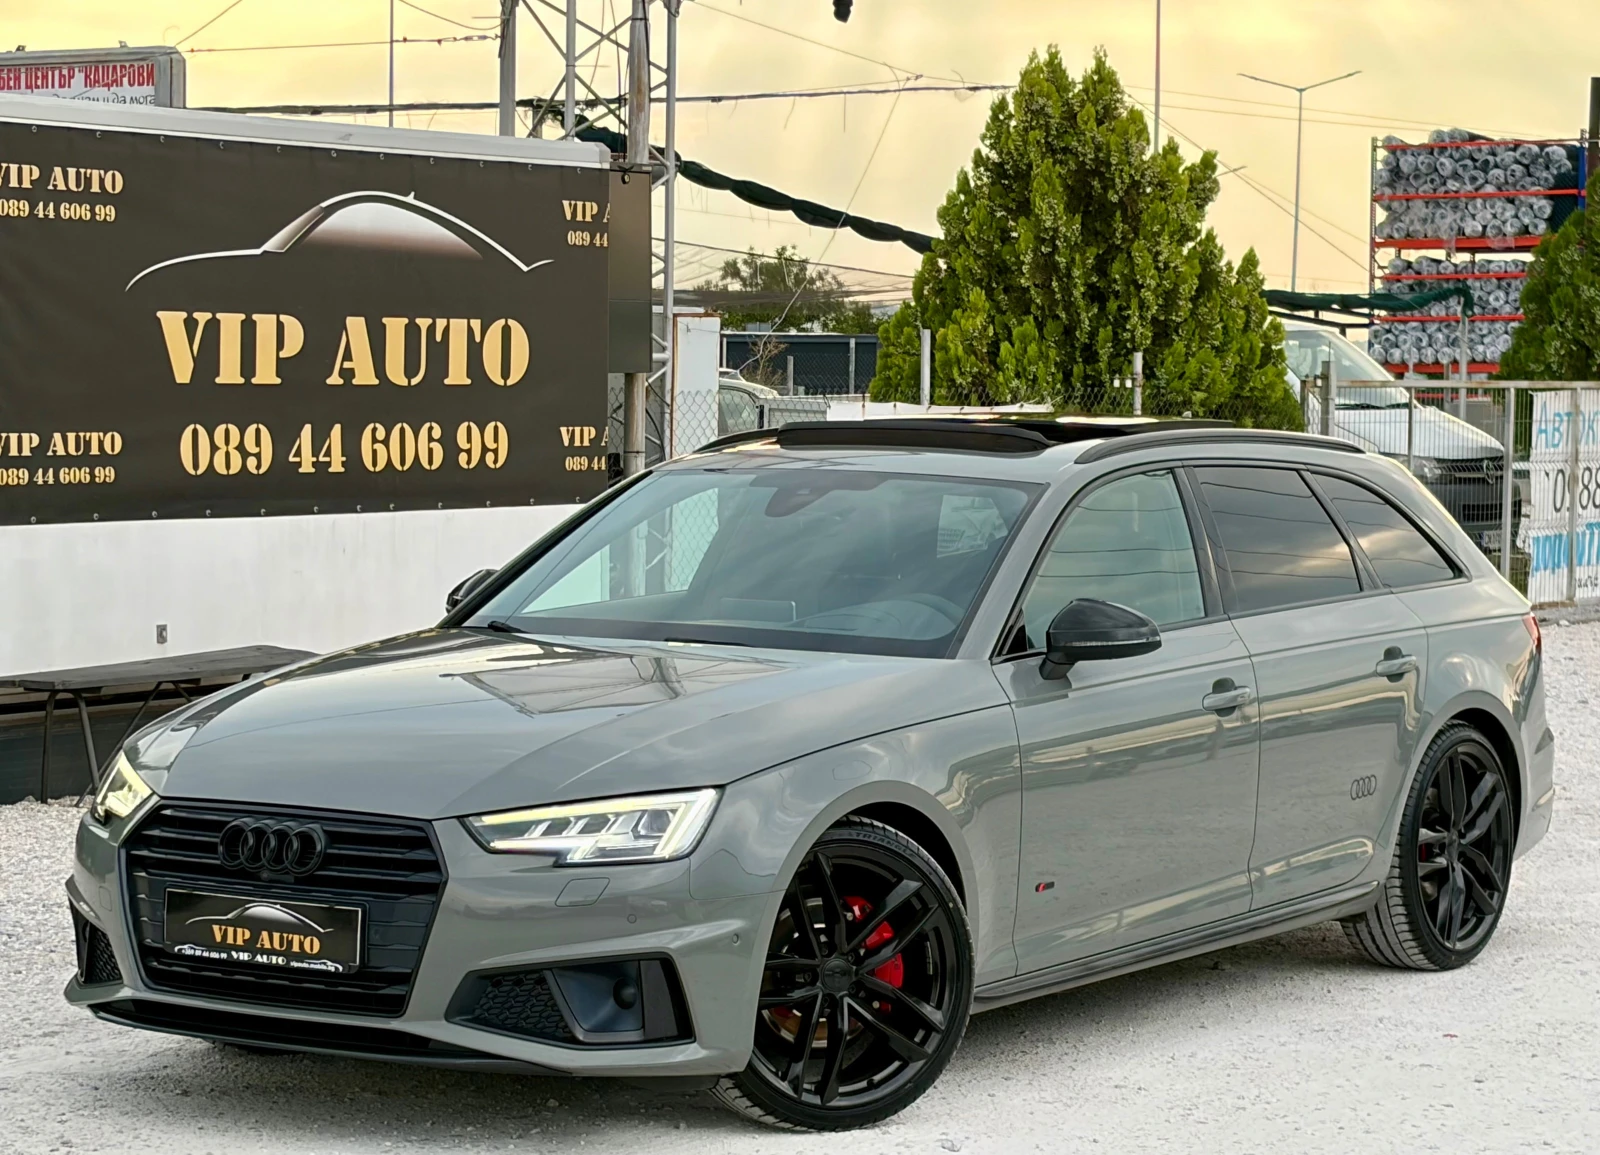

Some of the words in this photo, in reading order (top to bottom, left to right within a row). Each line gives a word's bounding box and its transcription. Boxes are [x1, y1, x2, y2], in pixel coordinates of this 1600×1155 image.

[25, 65, 75, 93] ЦЕНТЪР
[47, 166, 124, 194] AUTO
[0, 198, 30, 217] 089
[34, 201, 55, 219] 44
[60, 202, 91, 221] 606
[95, 204, 116, 222] 99
[561, 199, 599, 222] VIP
[567, 230, 591, 247] 089
[593, 231, 608, 248] 44
[156, 310, 305, 385] VIP
[325, 316, 530, 387] AUTO
[46, 431, 123, 456] AUTO
[179, 423, 273, 476] 089
[288, 423, 347, 474] 44
[360, 421, 444, 472] 606
[456, 420, 509, 470] 99
[559, 426, 597, 447] VIP
[0, 468, 30, 486] 089
[33, 467, 55, 485] 44
[59, 466, 91, 485] 606
[94, 465, 116, 484] 99
[565, 456, 589, 472] 089
[591, 456, 606, 471] 44
[212, 924, 251, 946] VIP
[256, 930, 320, 955] AUTO
[231, 950, 253, 961] VIP
[254, 953, 287, 966] AUTO
